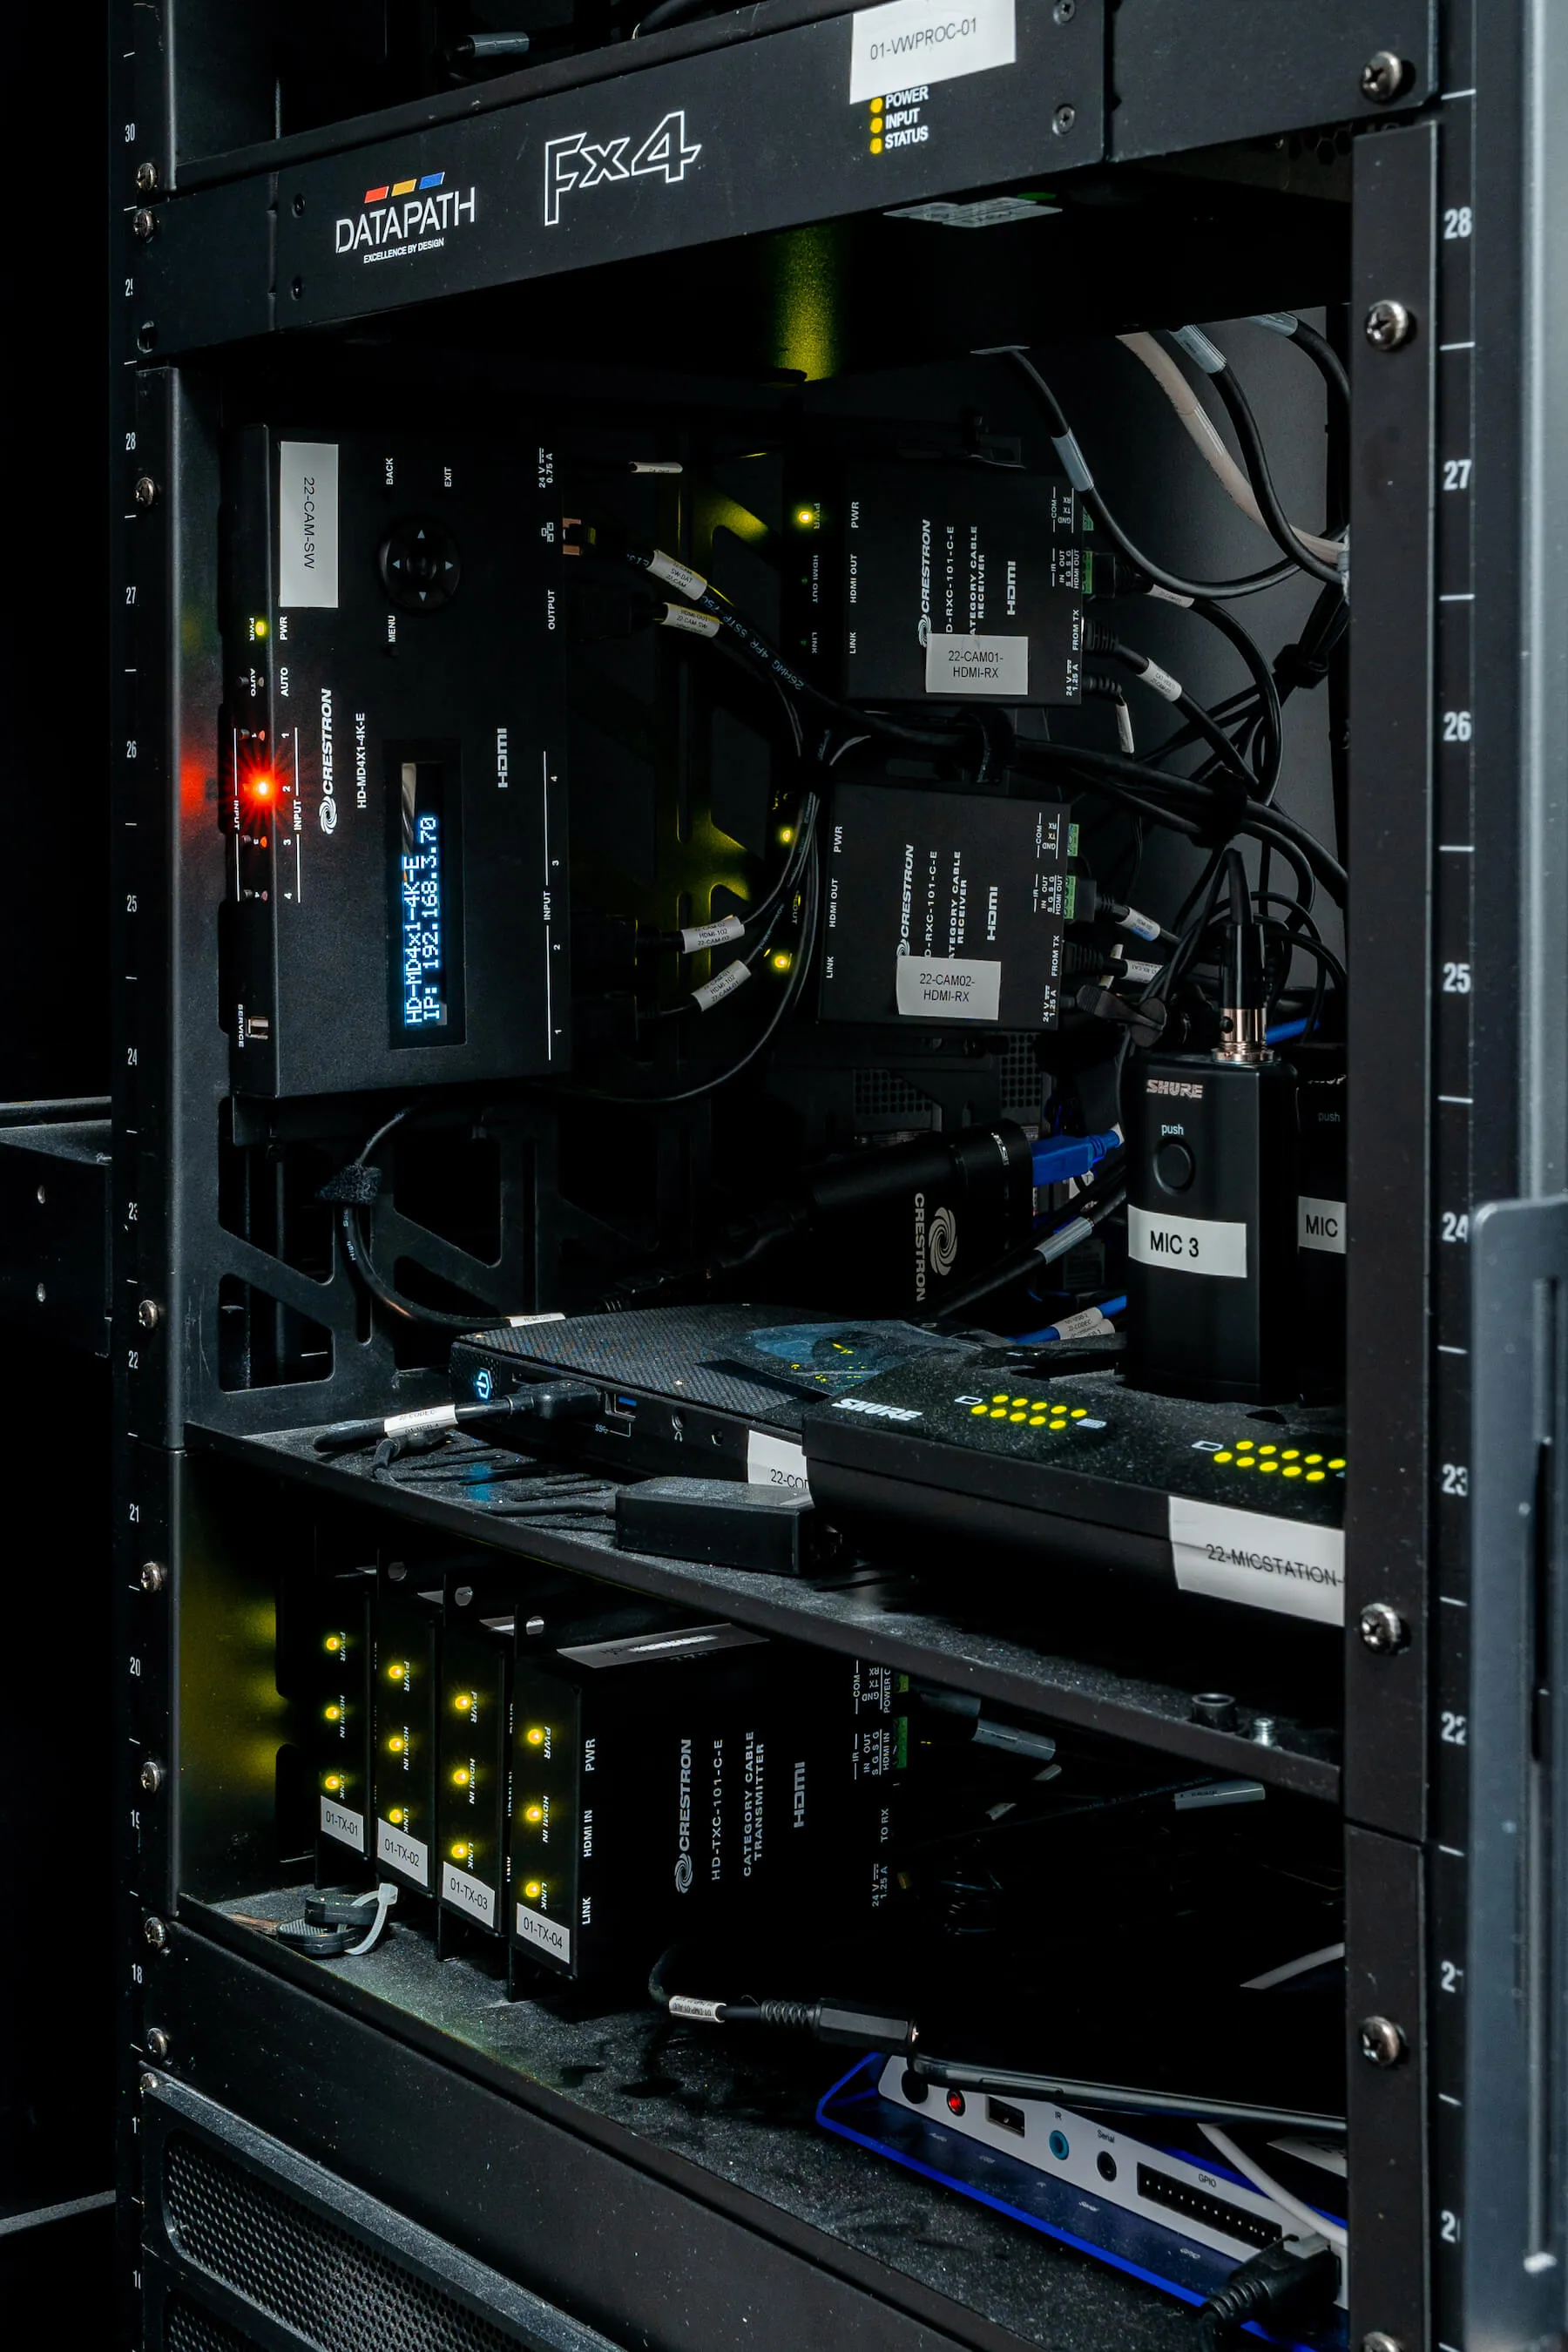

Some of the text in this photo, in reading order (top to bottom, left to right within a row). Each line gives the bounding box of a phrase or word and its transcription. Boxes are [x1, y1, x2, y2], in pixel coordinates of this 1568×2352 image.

[870, 18, 977, 61] 01-VWPROC-01
[885, 86, 929, 109] POWER
[885, 108, 920, 129] INPUT
[124, 122, 137, 144] 30
[885, 125, 929, 150] STATUS
[544, 110, 702, 226] Fx4
[335, 187, 476, 253] DATAPATH
[1443, 206, 1472, 240] 28
[363, 238, 444, 263] EXCELLENCE BY DESIGN
[125, 431, 137, 451] 28
[538, 476, 546, 488] 24
[546, 462, 554, 484] 0.75
[1443, 459, 1472, 490] 27
[303, 476, 316, 570] 22-CAM-SW
[850, 501, 859, 529] PWR
[970, 526, 978, 569] CABLE
[921, 520, 931, 613] CRESTRON
[945, 525, 955, 633] D-RXC-101-C-E
[125, 586, 138, 605] 27
[977, 554, 985, 619] RECEIVER
[1007, 561, 1016, 616] HDMI
[1072, 609, 1079, 618] TX
[280, 616, 288, 641] PWR
[948, 651, 1004, 663] 22-CAM01-
[280, 667, 289, 697] AUTO
[953, 667, 999, 679] HDMI-RX
[1066, 685, 1072, 697] 24
[1443, 711, 1472, 742] 26
[126, 740, 138, 760] 26
[321, 688, 335, 796] CRESTRON
[355, 712, 367, 809] HD-MD4X1-4K-E
[497, 728, 508, 788] HDMI
[293, 799, 302, 831] INPUT
[834, 825, 843, 853] PWR
[952, 851, 961, 894] CABLE
[126, 894, 138, 913] 25
[900, 844, 914, 939] CRESTRON
[420, 816, 441, 1020] IP: 192.168.3.70
[829, 899, 837, 928] HDMI
[957, 879, 967, 944] RECEIVER
[987, 887, 998, 941] HDMI
[403, 855, 423, 1024] HD-MD4x1-4K-E
[1053, 935, 1060, 946] TX
[920, 973, 976, 987] 22-CAM02-
[1443, 962, 1471, 994] 25
[923, 989, 970, 1003] HDMI-RX
[1042, 1012, 1049, 1022] 24
[127, 1047, 139, 1066] 24
[1146, 1079, 1203, 1099] SHURE
[1161, 1122, 1185, 1136] push
[1318, 1111, 1341, 1123] push
[1306, 1213, 1338, 1238] MIC
[1442, 1212, 1469, 1243] 24
[914, 1193, 926, 1302] CRESTRON
[1150, 1230, 1199, 1257] MIC 3
[128, 1350, 139, 1369] 22
[831, 1398, 923, 1422] SHURE
[1442, 1463, 1468, 1497] 23
[129, 1503, 139, 1523] 21
[1206, 1544, 1345, 1587] 22-MICSTATION-
[129, 1656, 141, 1677] 20
[862, 1692, 879, 1701] GND
[340, 1725, 345, 1738] IN
[544, 1725, 552, 1761] PWR
[883, 1732, 890, 1743] IN
[1442, 1712, 1467, 1746] 22
[403, 1758, 409, 1771] IN
[585, 1738, 595, 1772] PWR
[852, 1751, 859, 1763] IR
[864, 1762, 870, 1774] IN
[469, 1791, 475, 1805] IN
[679, 1739, 692, 1852] CRESTRON
[743, 1731, 754, 1877] CATEGORY CABLE
[754, 1743, 764, 1862] TRANSMITTER
[794, 1762, 805, 1828] HDMI
[325, 1809, 359, 1838] 01-TX-01
[711, 1739, 723, 1881] HD-TXC-101-C-E
[542, 1829, 549, 1844] IN
[583, 1809, 593, 1858] HDMI IN
[881, 1808, 889, 1842] TO RX
[384, 1838, 420, 1868] 01-TX-02
[449, 1877, 488, 1912] 01-TX-03
[872, 1893, 880, 1908] 24
[582, 1896, 591, 1925] LINK
[523, 1916, 564, 1950] 01-TX-04
[131, 1962, 143, 1984] 18
[1055, 2111, 1062, 2121] IR
[1097, 2129, 1115, 2144] Serial
[1198, 2173, 1217, 2188] GPIO
